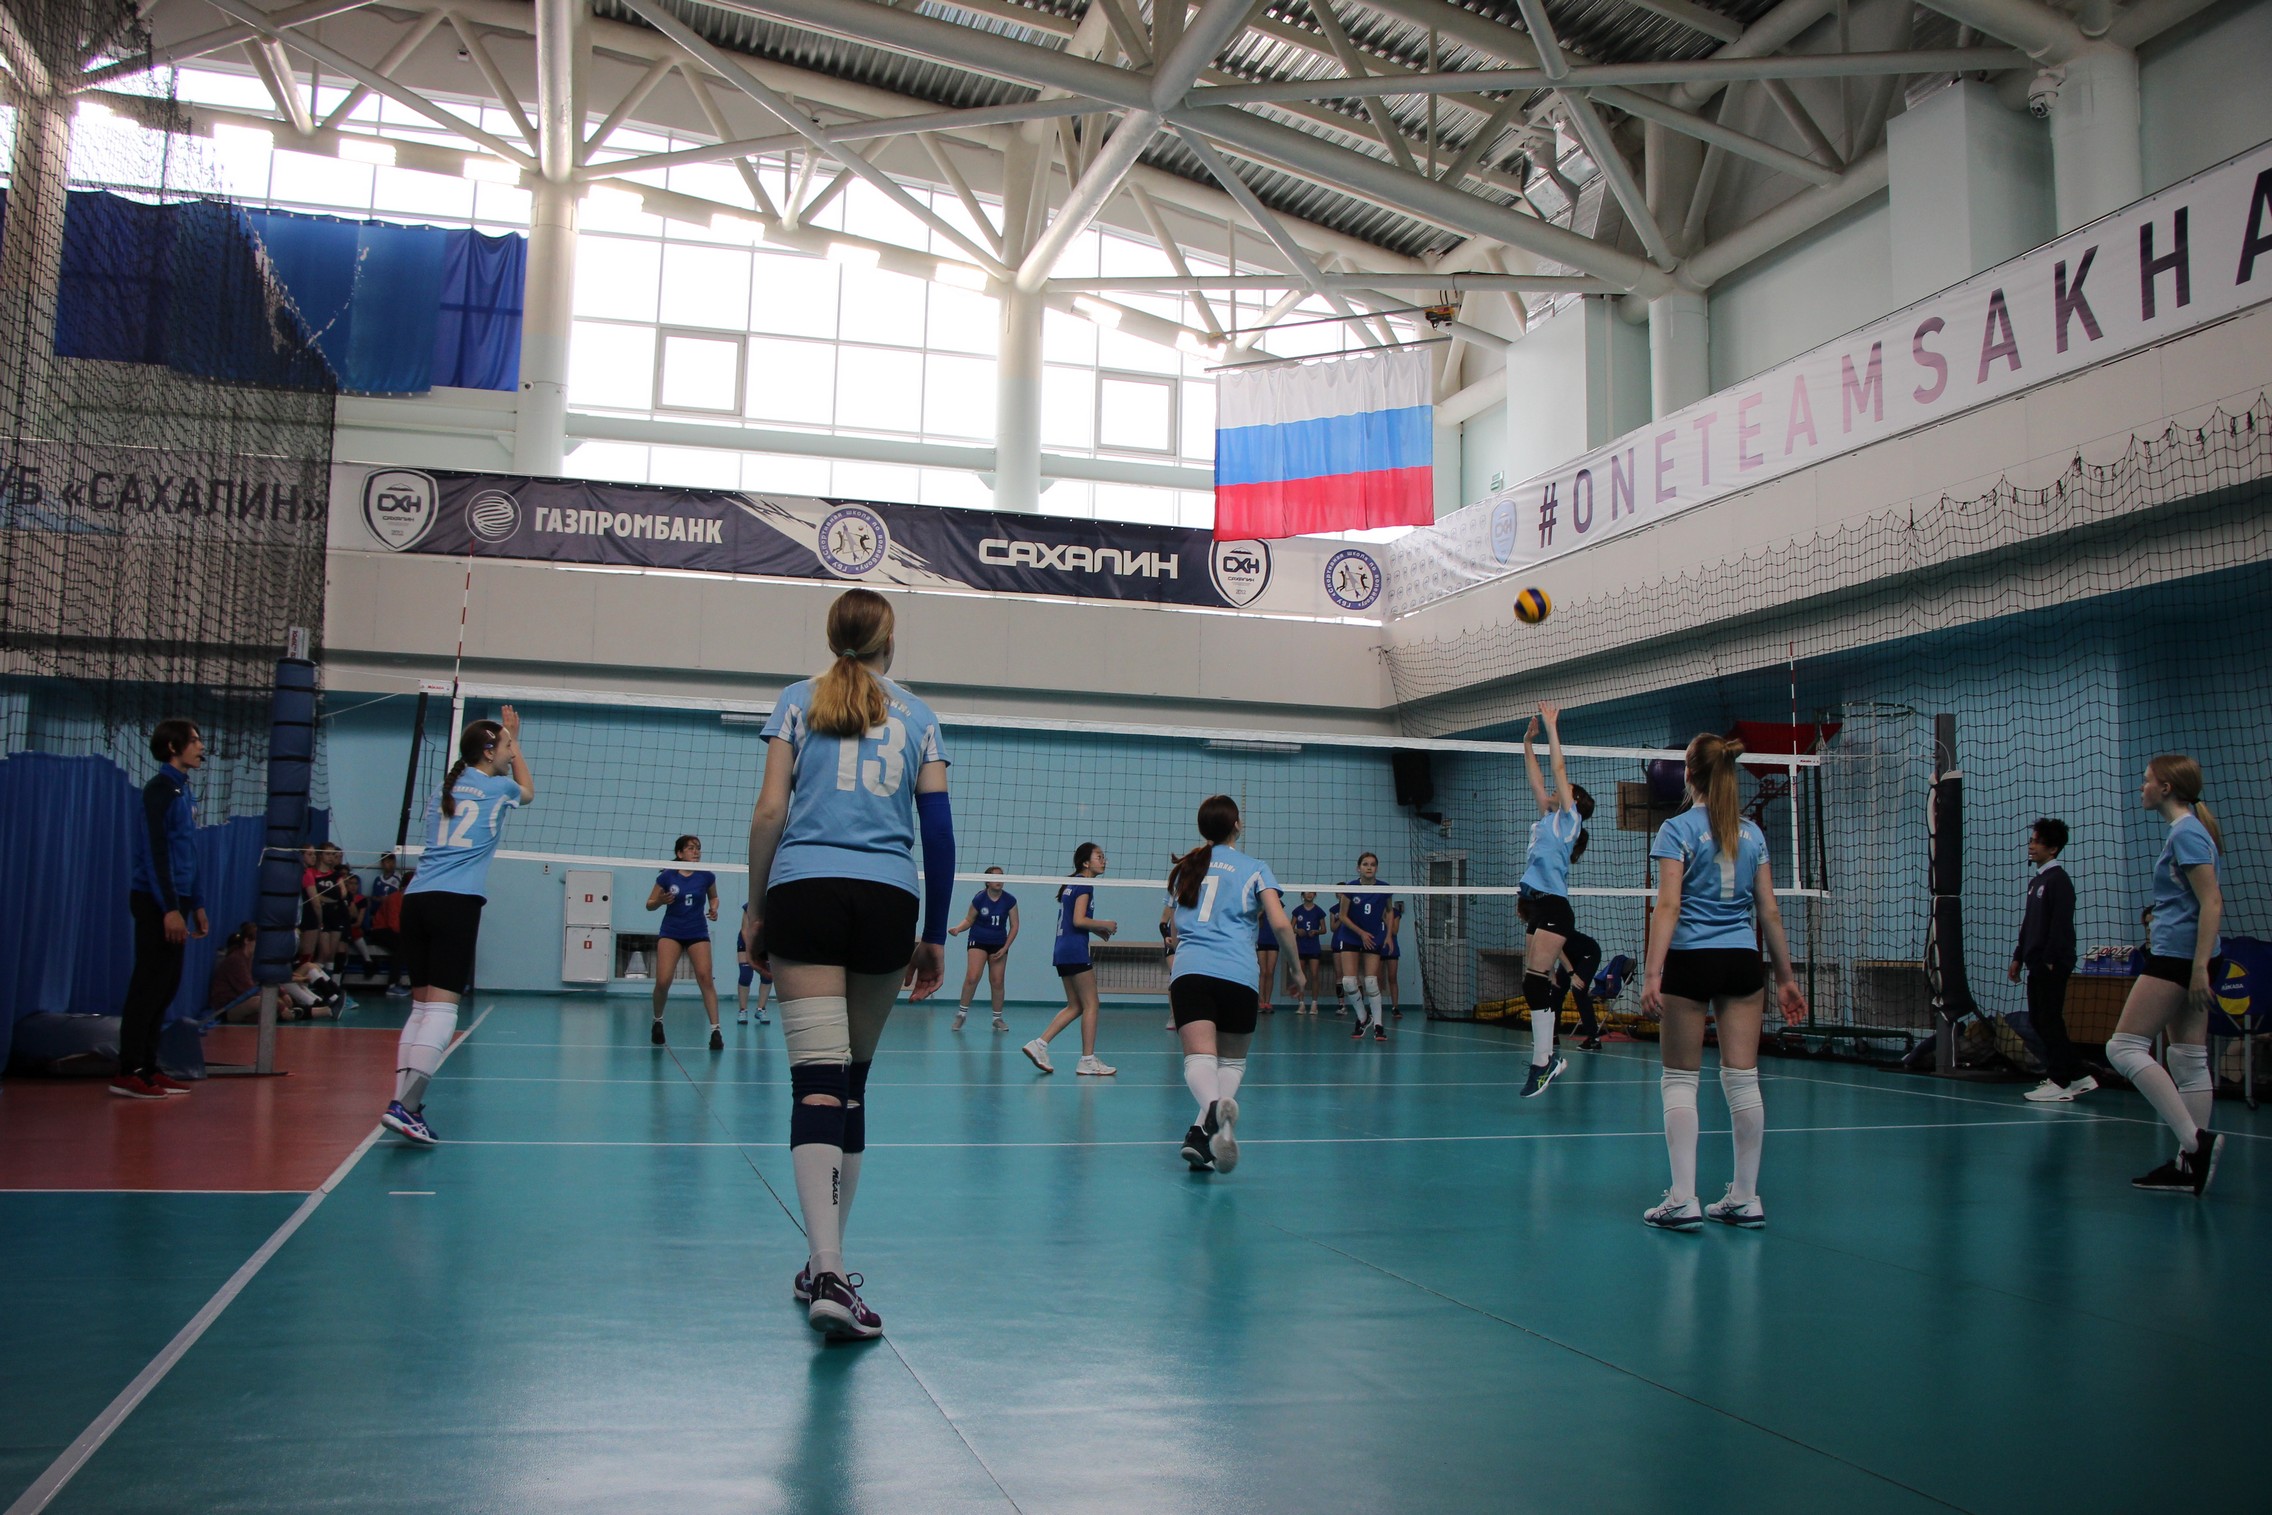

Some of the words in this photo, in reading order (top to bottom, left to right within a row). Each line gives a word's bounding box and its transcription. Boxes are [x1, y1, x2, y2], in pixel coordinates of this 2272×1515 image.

[534, 506, 724, 545] ГАЗПРОМБАНК
[978, 537, 1179, 580] САХАЛИН
[836, 716, 907, 797] 13
[436, 799, 480, 848] 12
[1713, 851, 1735, 898] 1
[991, 915, 1000, 926] 11
[1305, 921, 1312, 931] 5
[1364, 903, 1372, 915] 9
